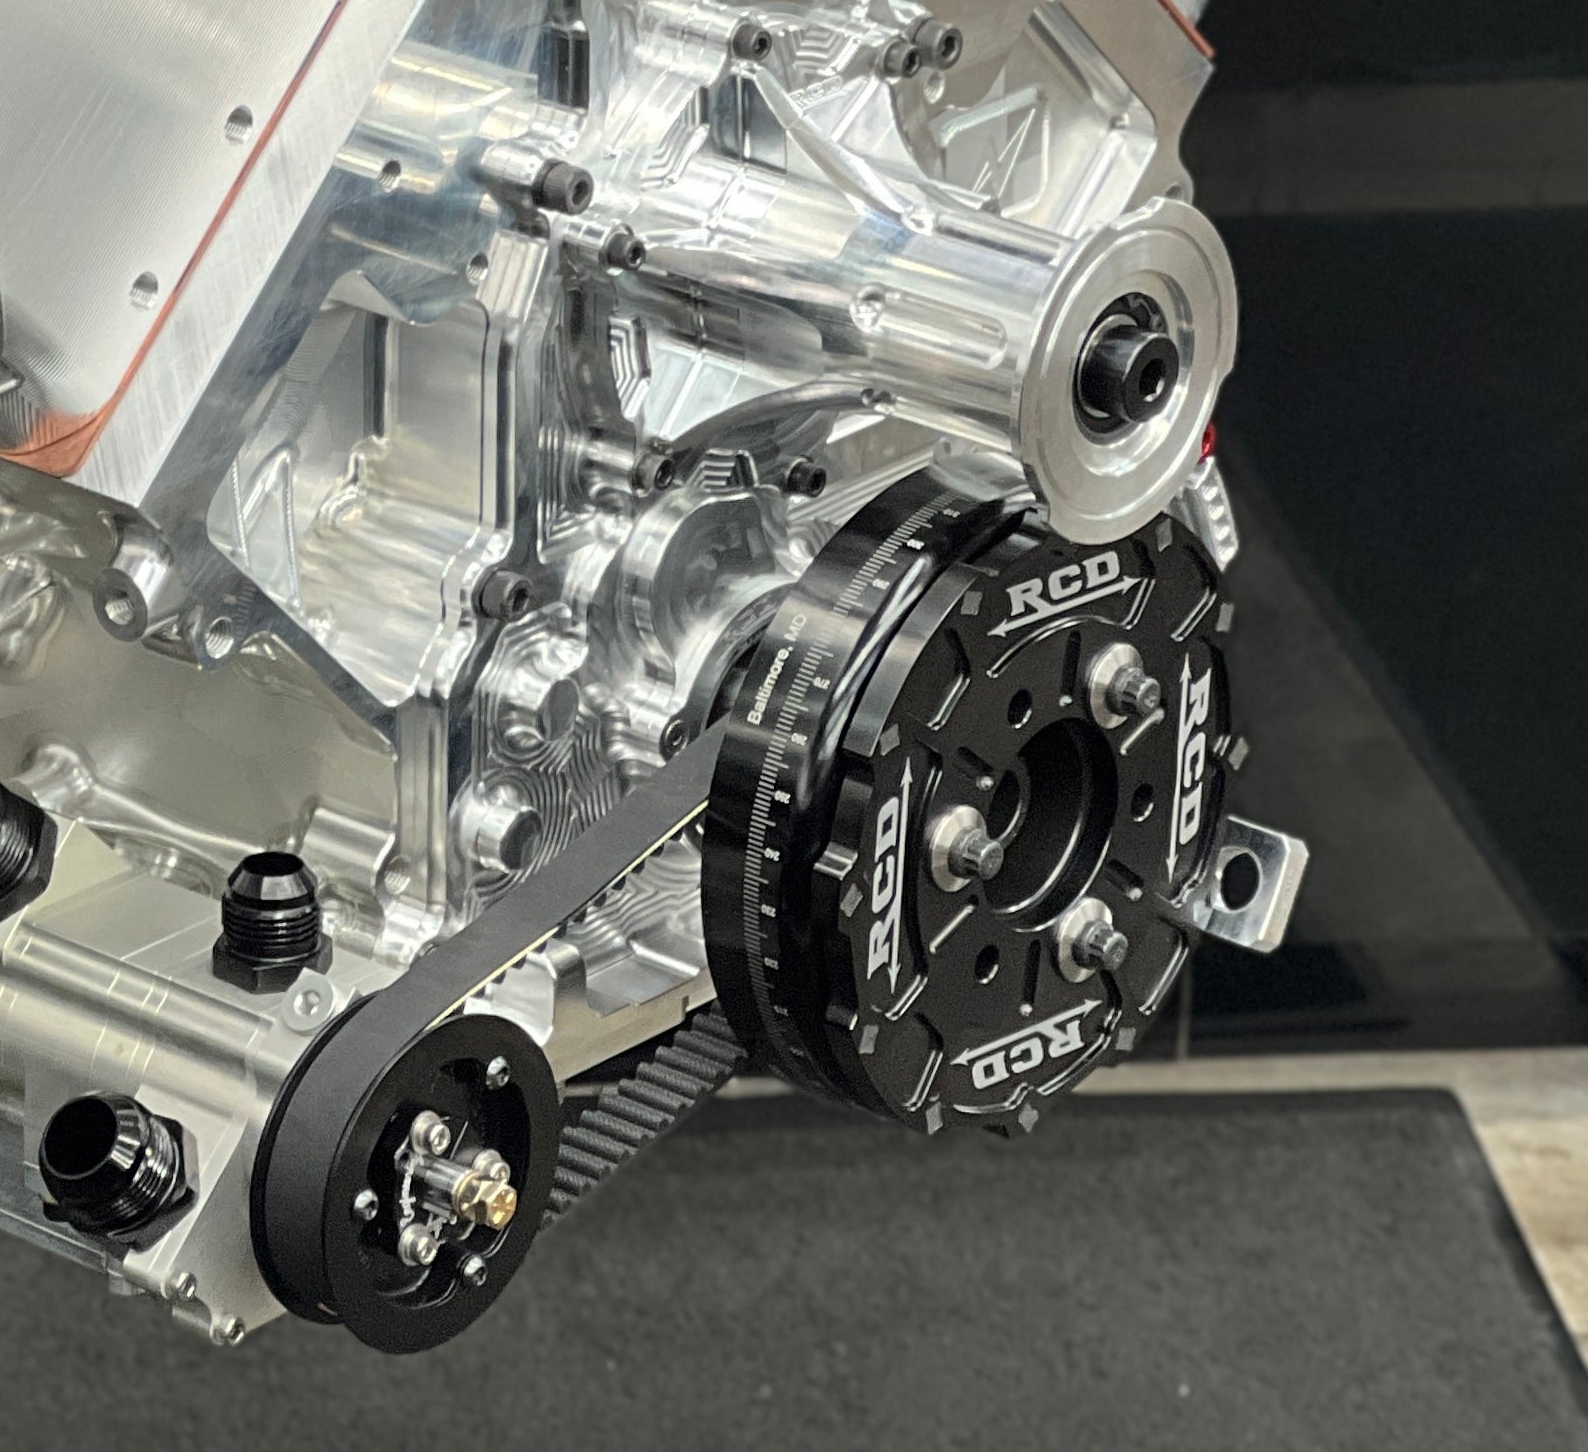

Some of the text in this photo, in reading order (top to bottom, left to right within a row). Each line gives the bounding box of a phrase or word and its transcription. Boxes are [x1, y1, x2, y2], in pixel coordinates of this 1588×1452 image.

[1006, 550, 1121, 617] RCD
[783, 613, 807, 643] MD
[1178, 667, 1212, 845] RCD
[866, 795, 900, 981] RCD
[971, 1019, 1086, 1090] RCD
